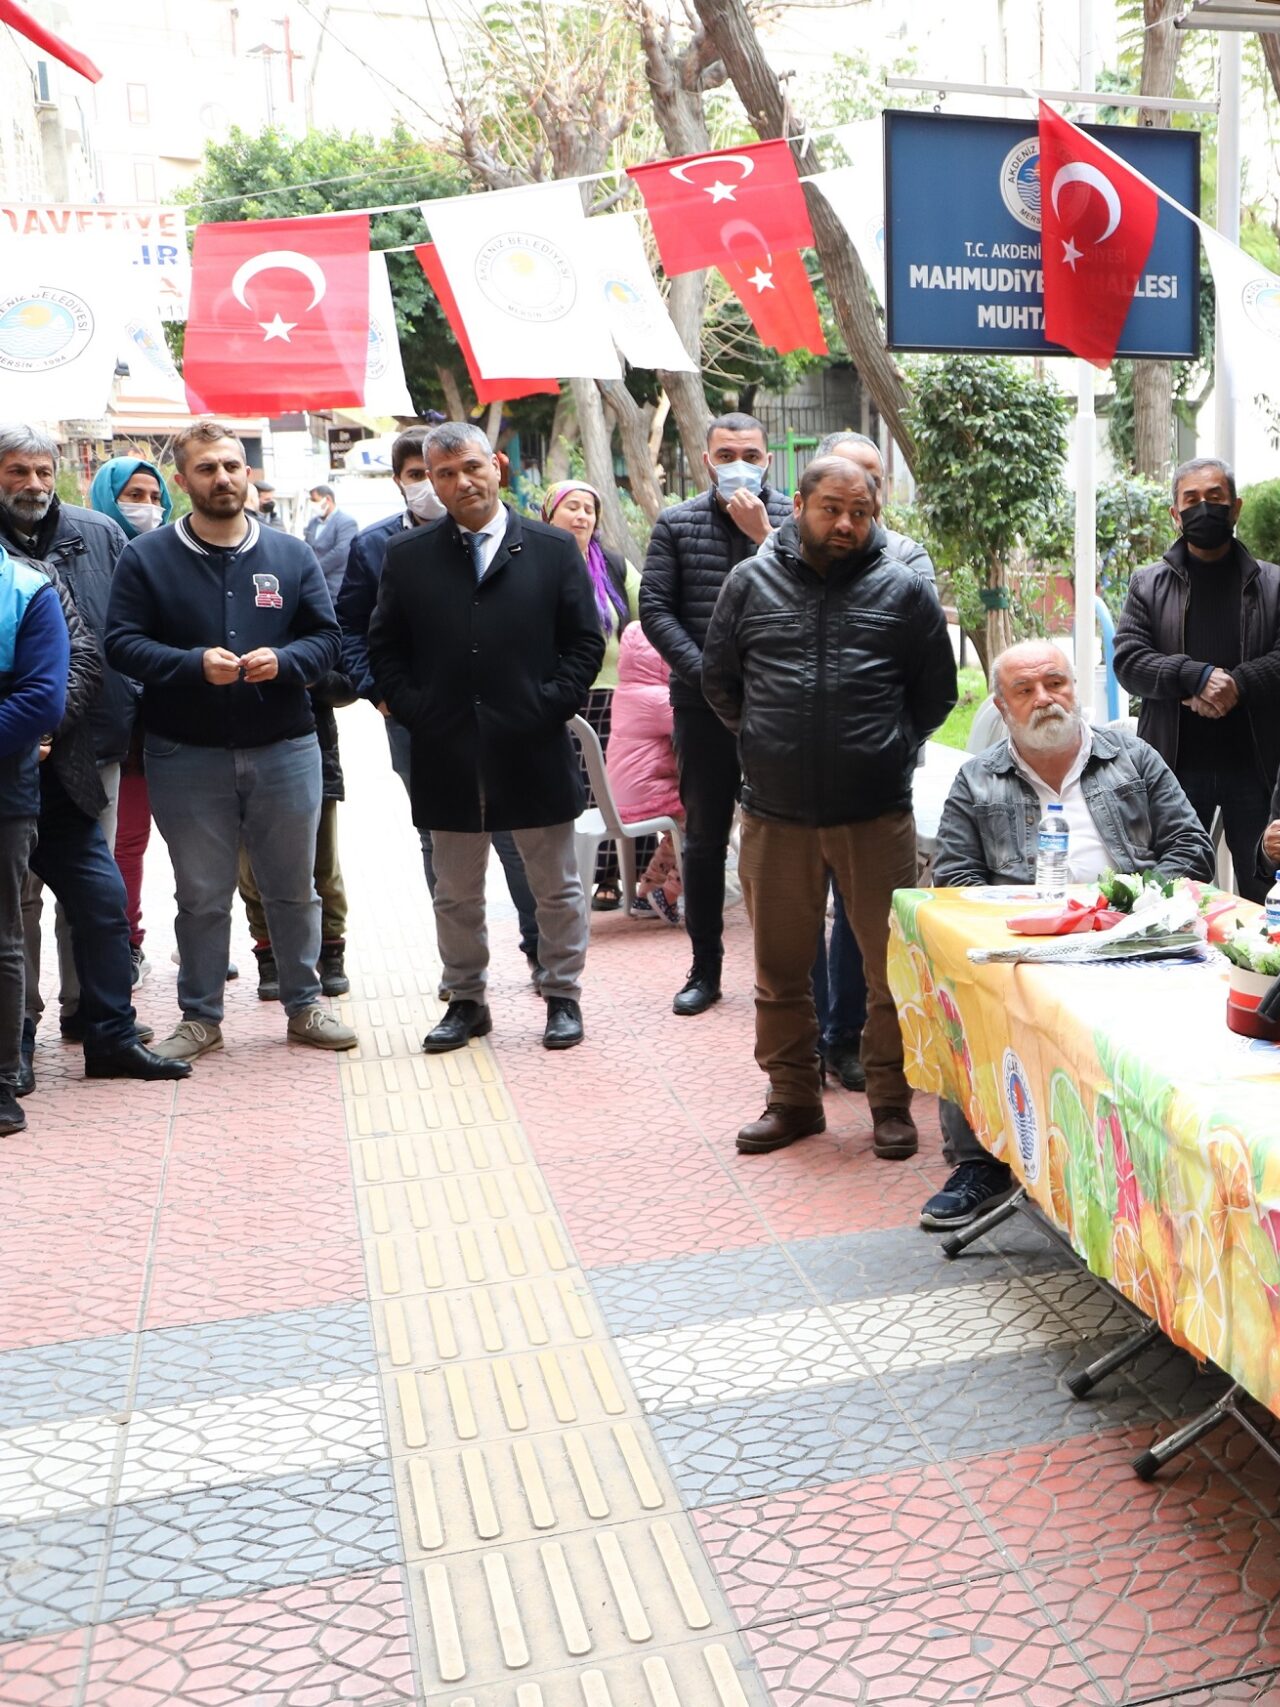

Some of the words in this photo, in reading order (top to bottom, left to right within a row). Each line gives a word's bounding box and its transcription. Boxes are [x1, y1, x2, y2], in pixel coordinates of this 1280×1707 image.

[1020, 208, 1041, 224] MERS
[964, 241, 988, 258] T.C.
[991, 243, 1042, 260] AKDENİ
[977, 305, 1046, 331] MUHT
